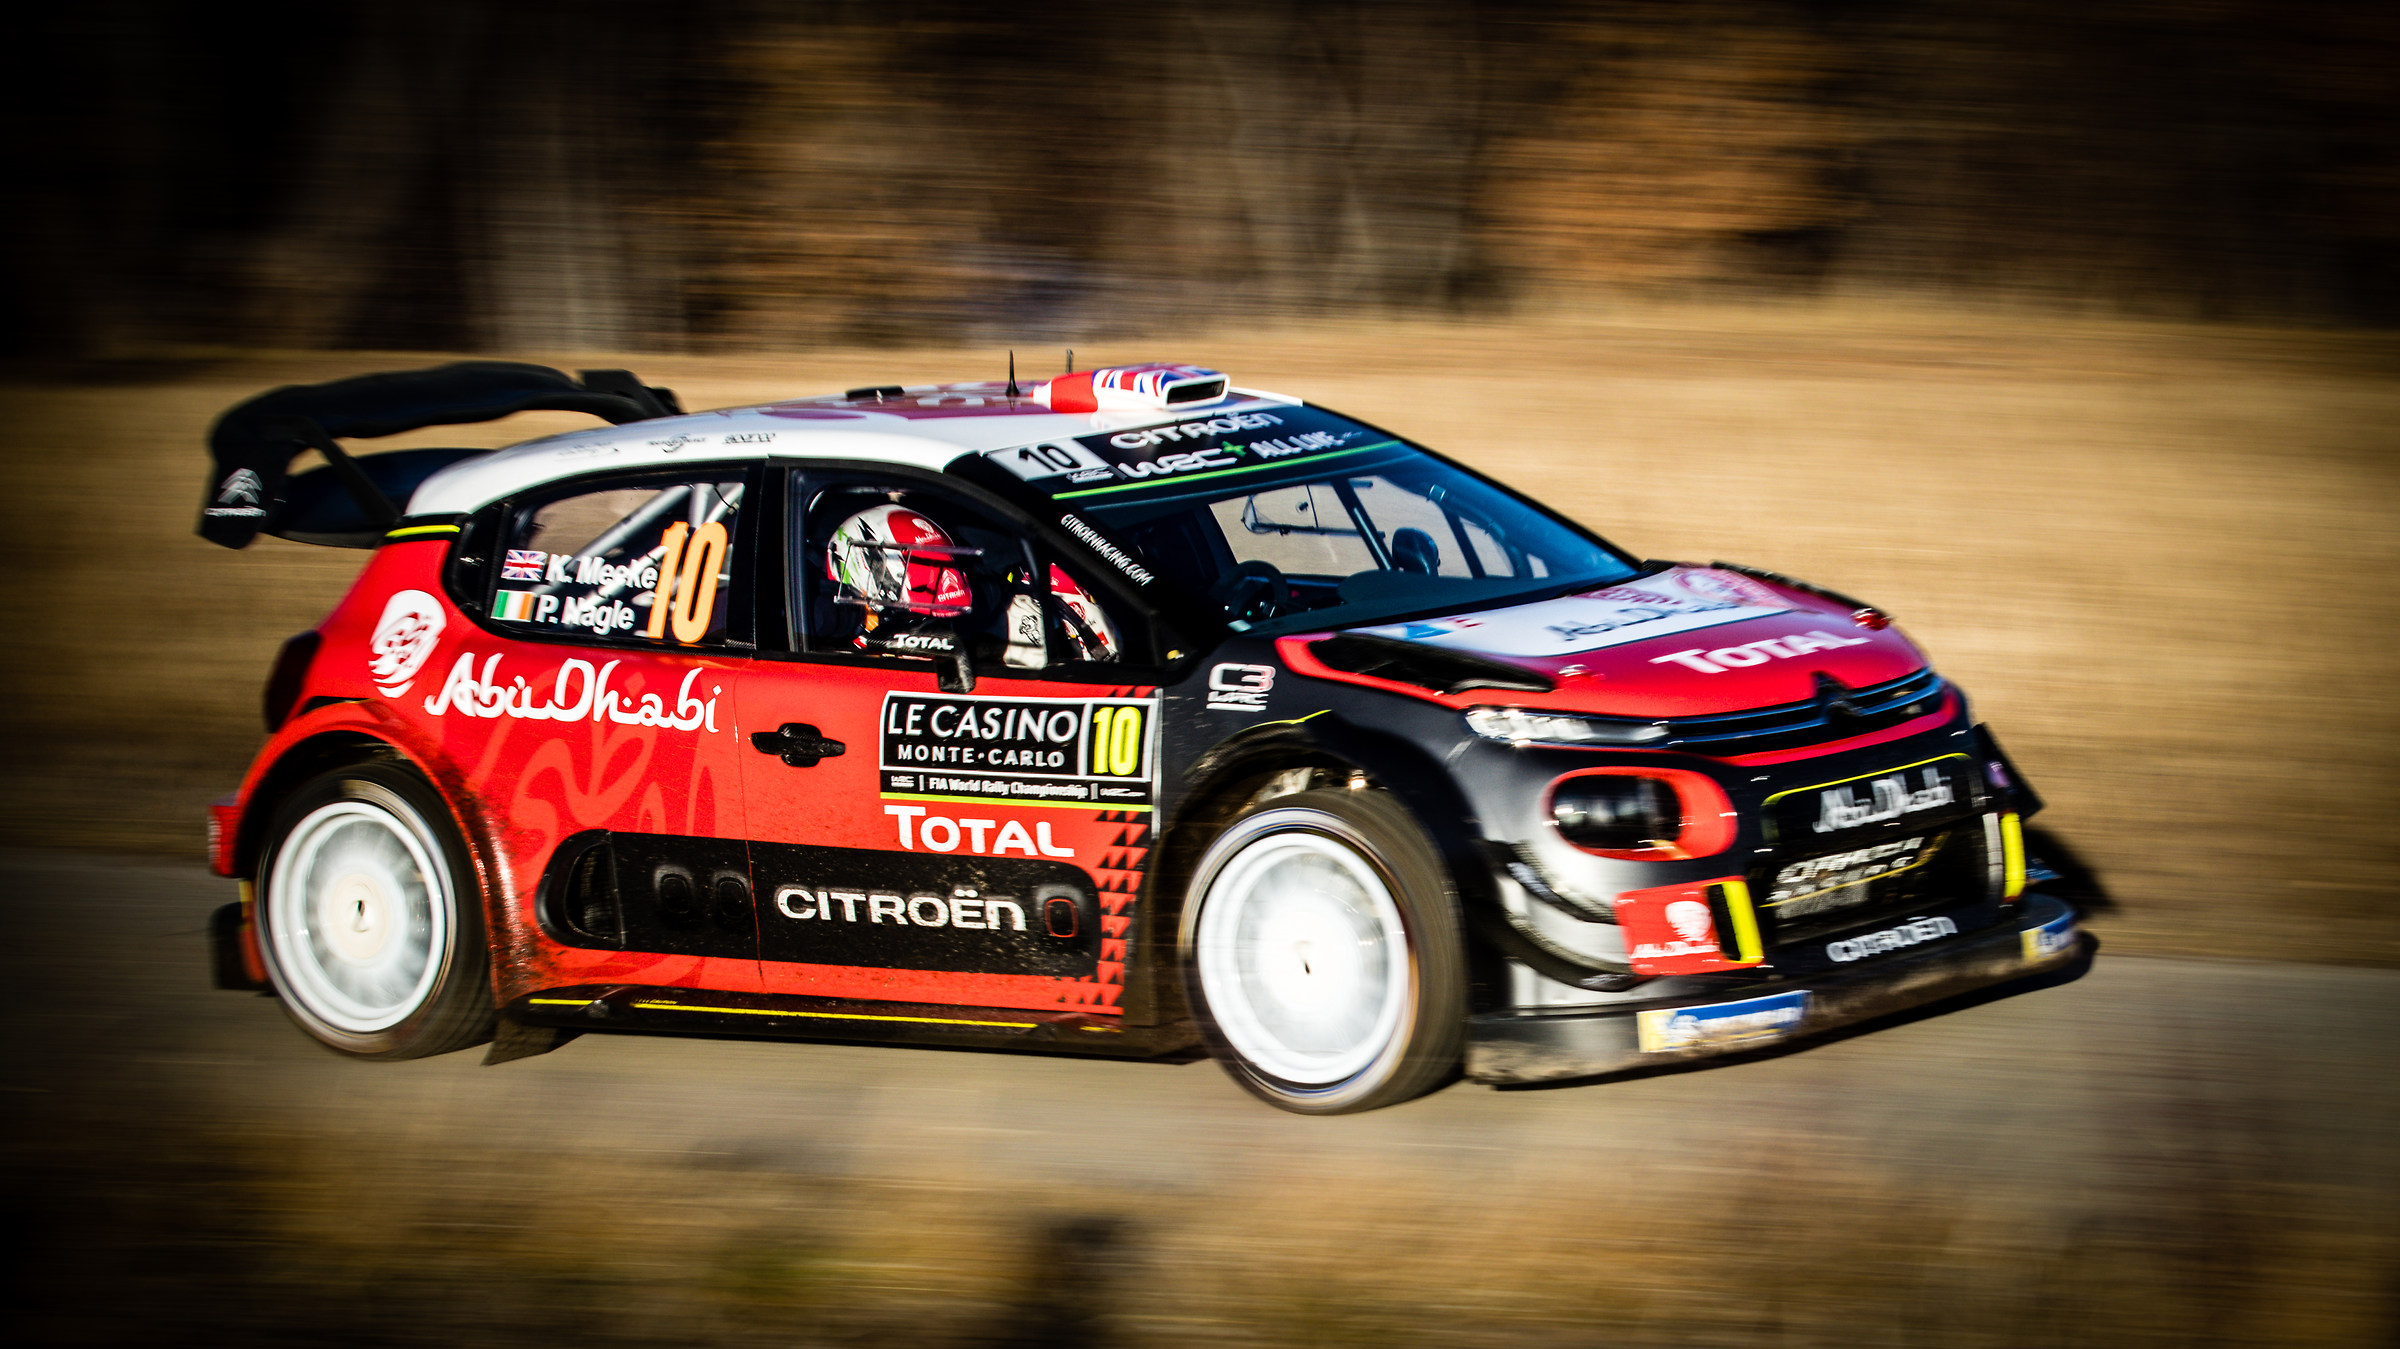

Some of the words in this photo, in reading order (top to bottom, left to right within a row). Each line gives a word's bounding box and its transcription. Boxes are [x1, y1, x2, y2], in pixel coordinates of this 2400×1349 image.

[1018, 443, 1081, 472] 10
[545, 554, 573, 583] K.
[576, 556, 658, 589] Meeke
[647, 521, 728, 643] 10
[534, 595, 560, 624] P.
[561, 596, 636, 635] Nagle
[893, 634, 955, 650] TOTAL
[1648, 630, 1873, 673] TOTAL
[1208, 662, 1277, 693] C3
[888, 703, 926, 736] LE
[930, 704, 1079, 743] CASINO
[1092, 706, 1142, 776] 10
[929, 777, 948, 790] FIA
[948, 778, 981, 792] World
[981, 780, 1010, 796] Rally
[1010, 781, 1089, 799] Championship
[883, 805, 1075, 858] TOTAL
[775, 888, 1028, 931] CITROËN
